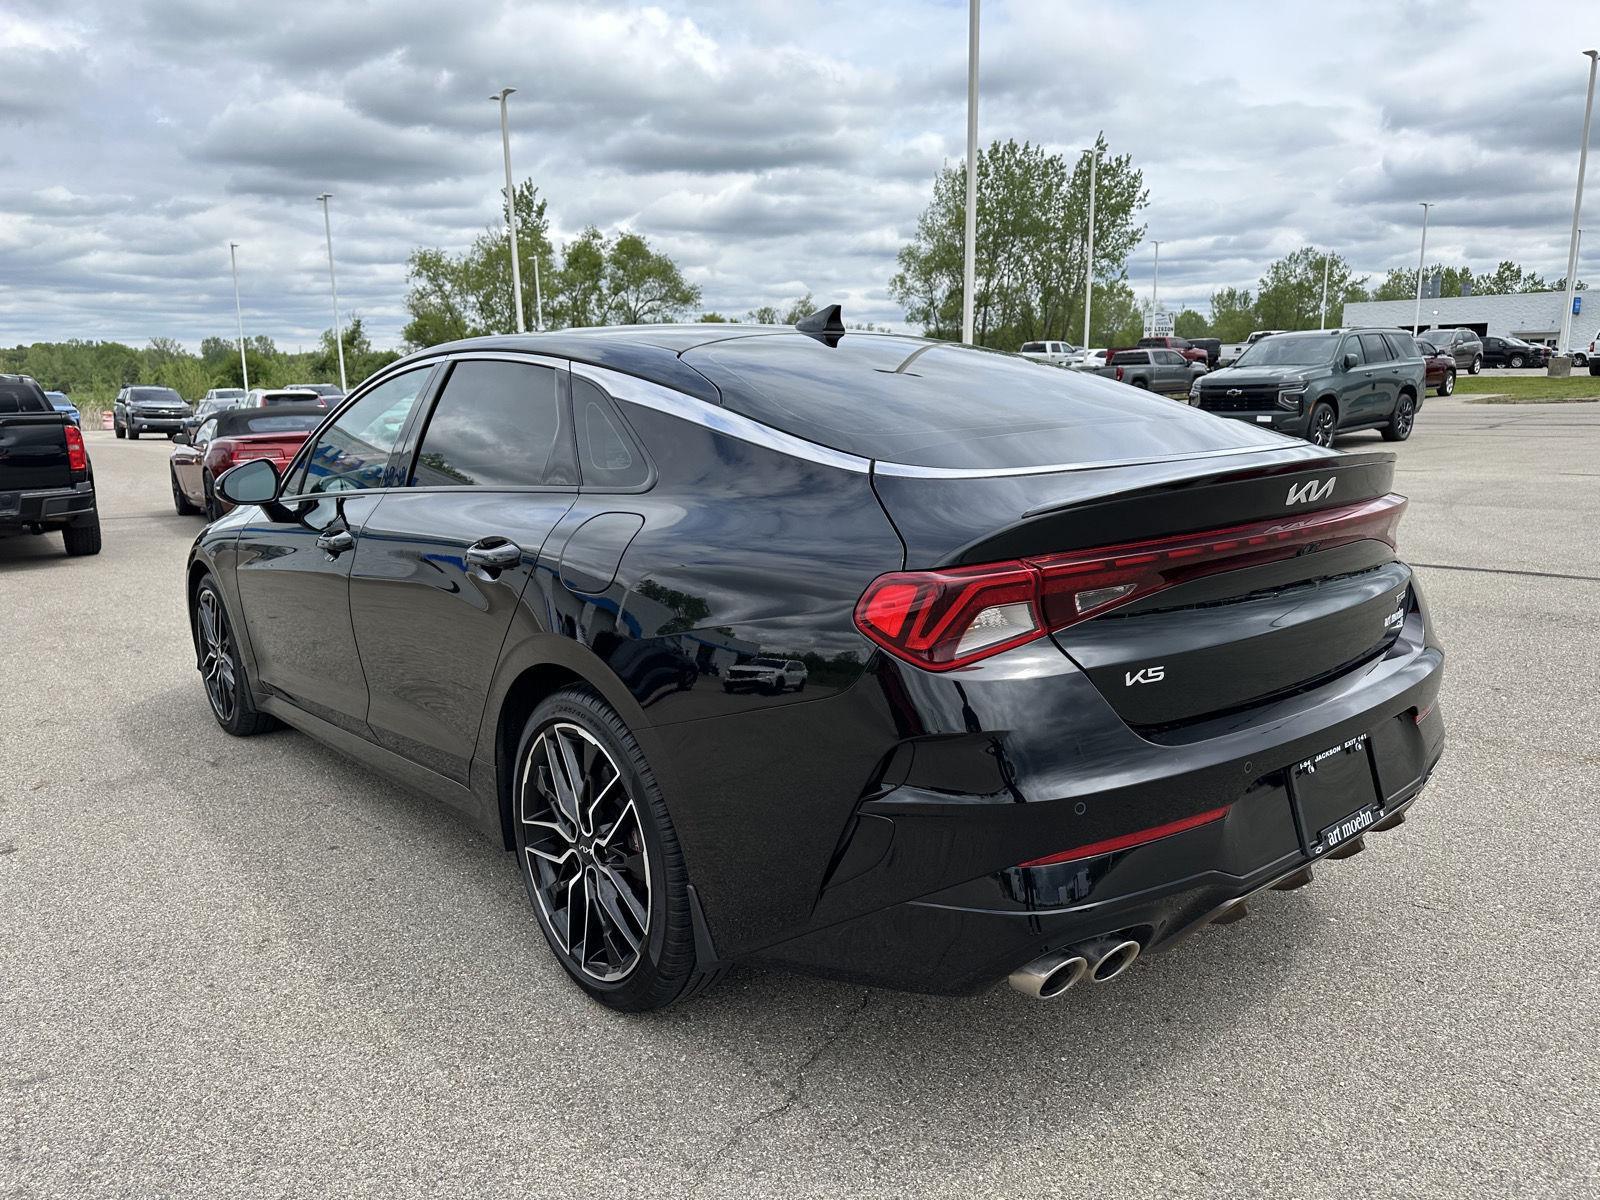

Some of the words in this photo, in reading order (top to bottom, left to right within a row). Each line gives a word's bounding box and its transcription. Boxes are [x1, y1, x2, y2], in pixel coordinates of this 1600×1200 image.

[1285, 476, 1337, 506] KIA
[1125, 665, 1165, 687] K5
[1300, 760, 1310, 769] I-94
[1315, 746, 1341, 762] JACKSON
[1344, 738, 1356, 748] EXIT
[1357, 733, 1367, 741] 141
[1328, 826, 1341, 845] art
[1342, 811, 1373, 837] moehn
